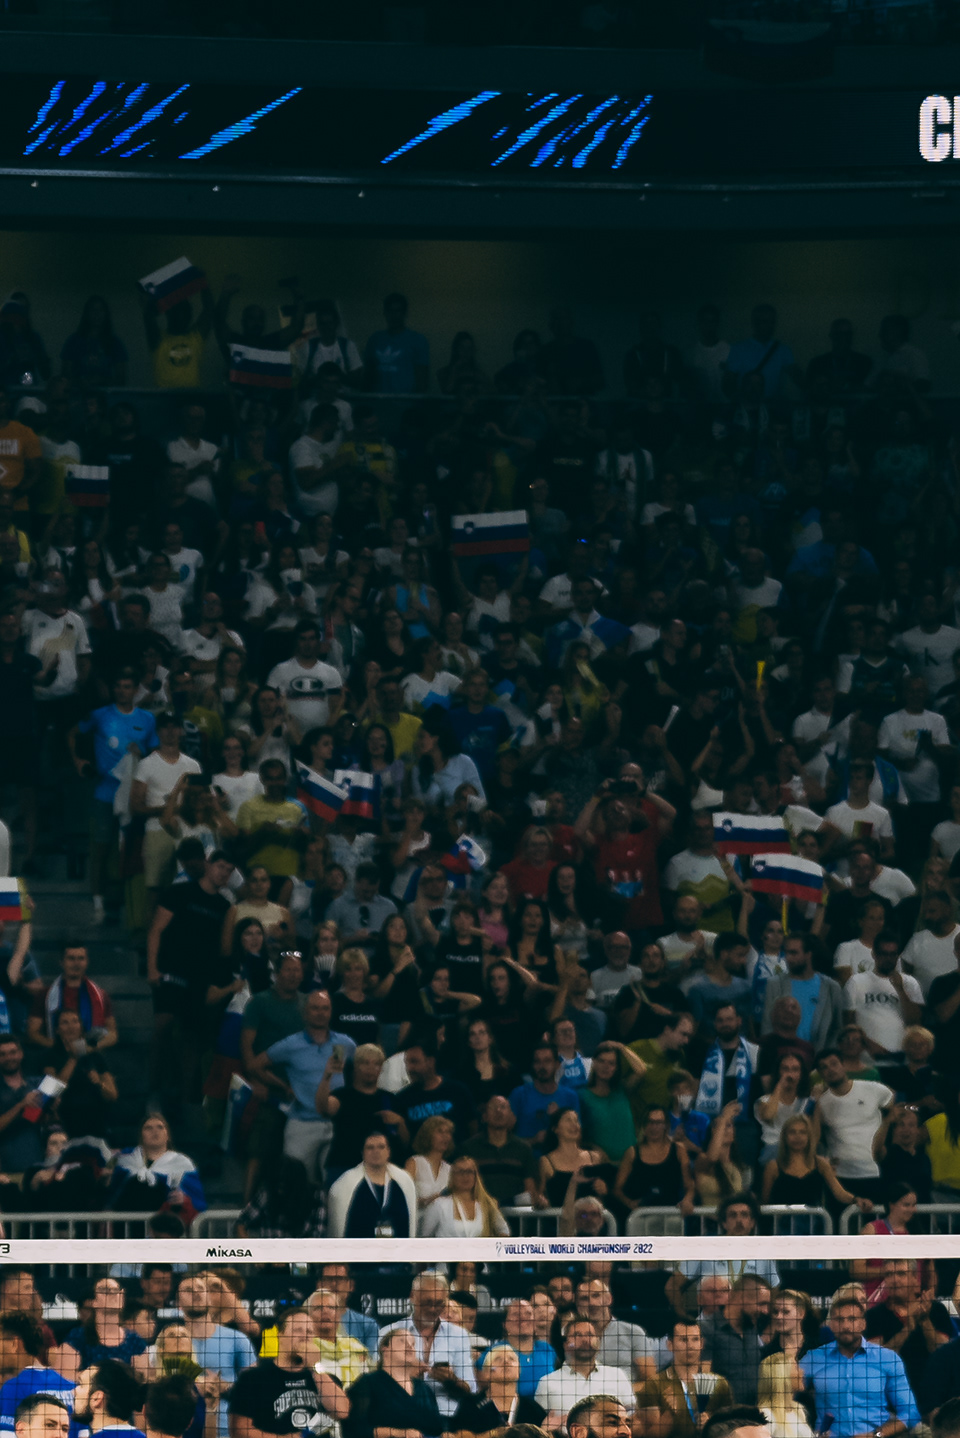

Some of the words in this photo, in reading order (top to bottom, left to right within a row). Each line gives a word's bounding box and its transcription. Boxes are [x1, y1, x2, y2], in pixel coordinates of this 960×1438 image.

[504, 1244, 545, 1254] VOLLEYBALL
[548, 1244, 575, 1254] WORLD
[577, 1243, 631, 1254] CHAMPIONSHIP
